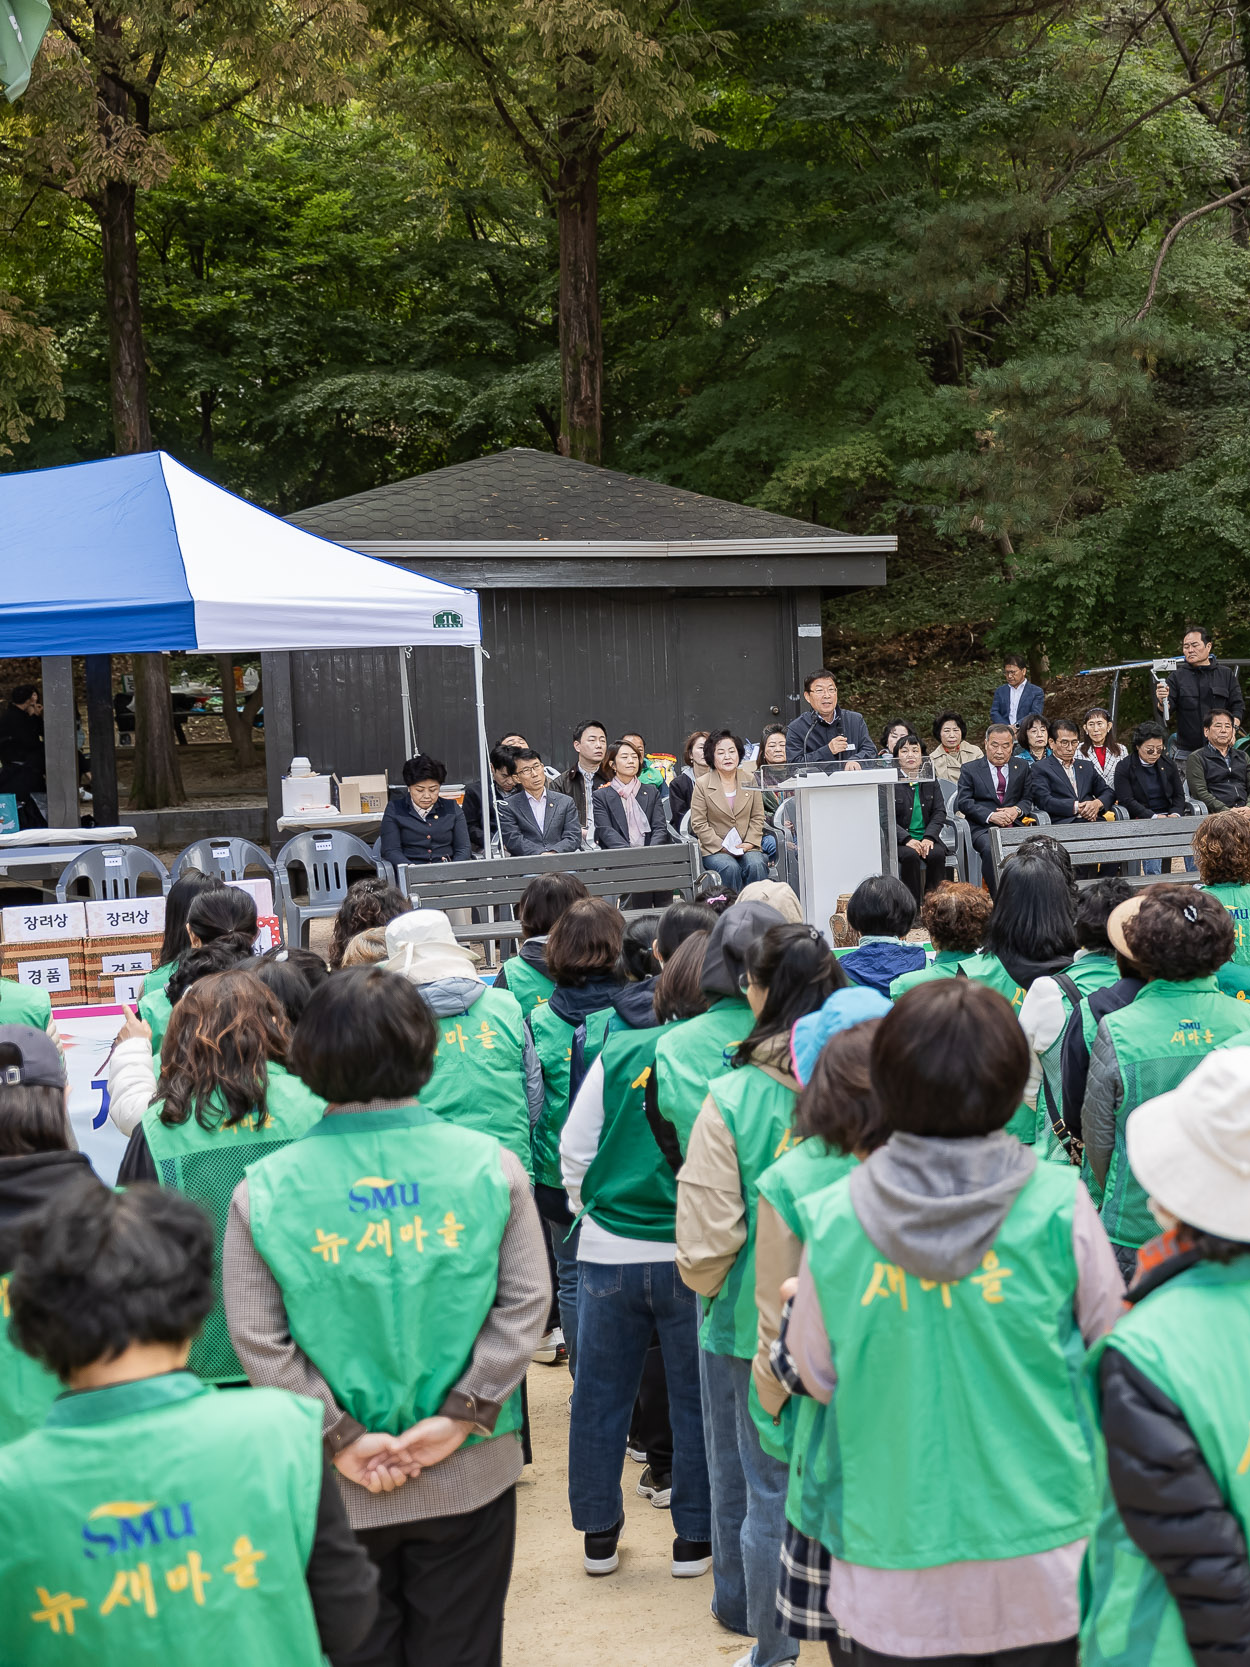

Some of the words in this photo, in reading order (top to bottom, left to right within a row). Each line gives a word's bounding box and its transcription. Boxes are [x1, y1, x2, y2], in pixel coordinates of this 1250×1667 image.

[24, 913, 69, 931] 장려상
[107, 909, 150, 926] 장려상
[1228, 908, 1249, 919] MU
[1178, 1021, 1201, 1031] SMU
[434, 1021, 498, 1056] 마을
[1171, 1028, 1214, 1046] 새마을
[348, 1182, 420, 1213] SMU
[82, 1502, 197, 1560] SMU
